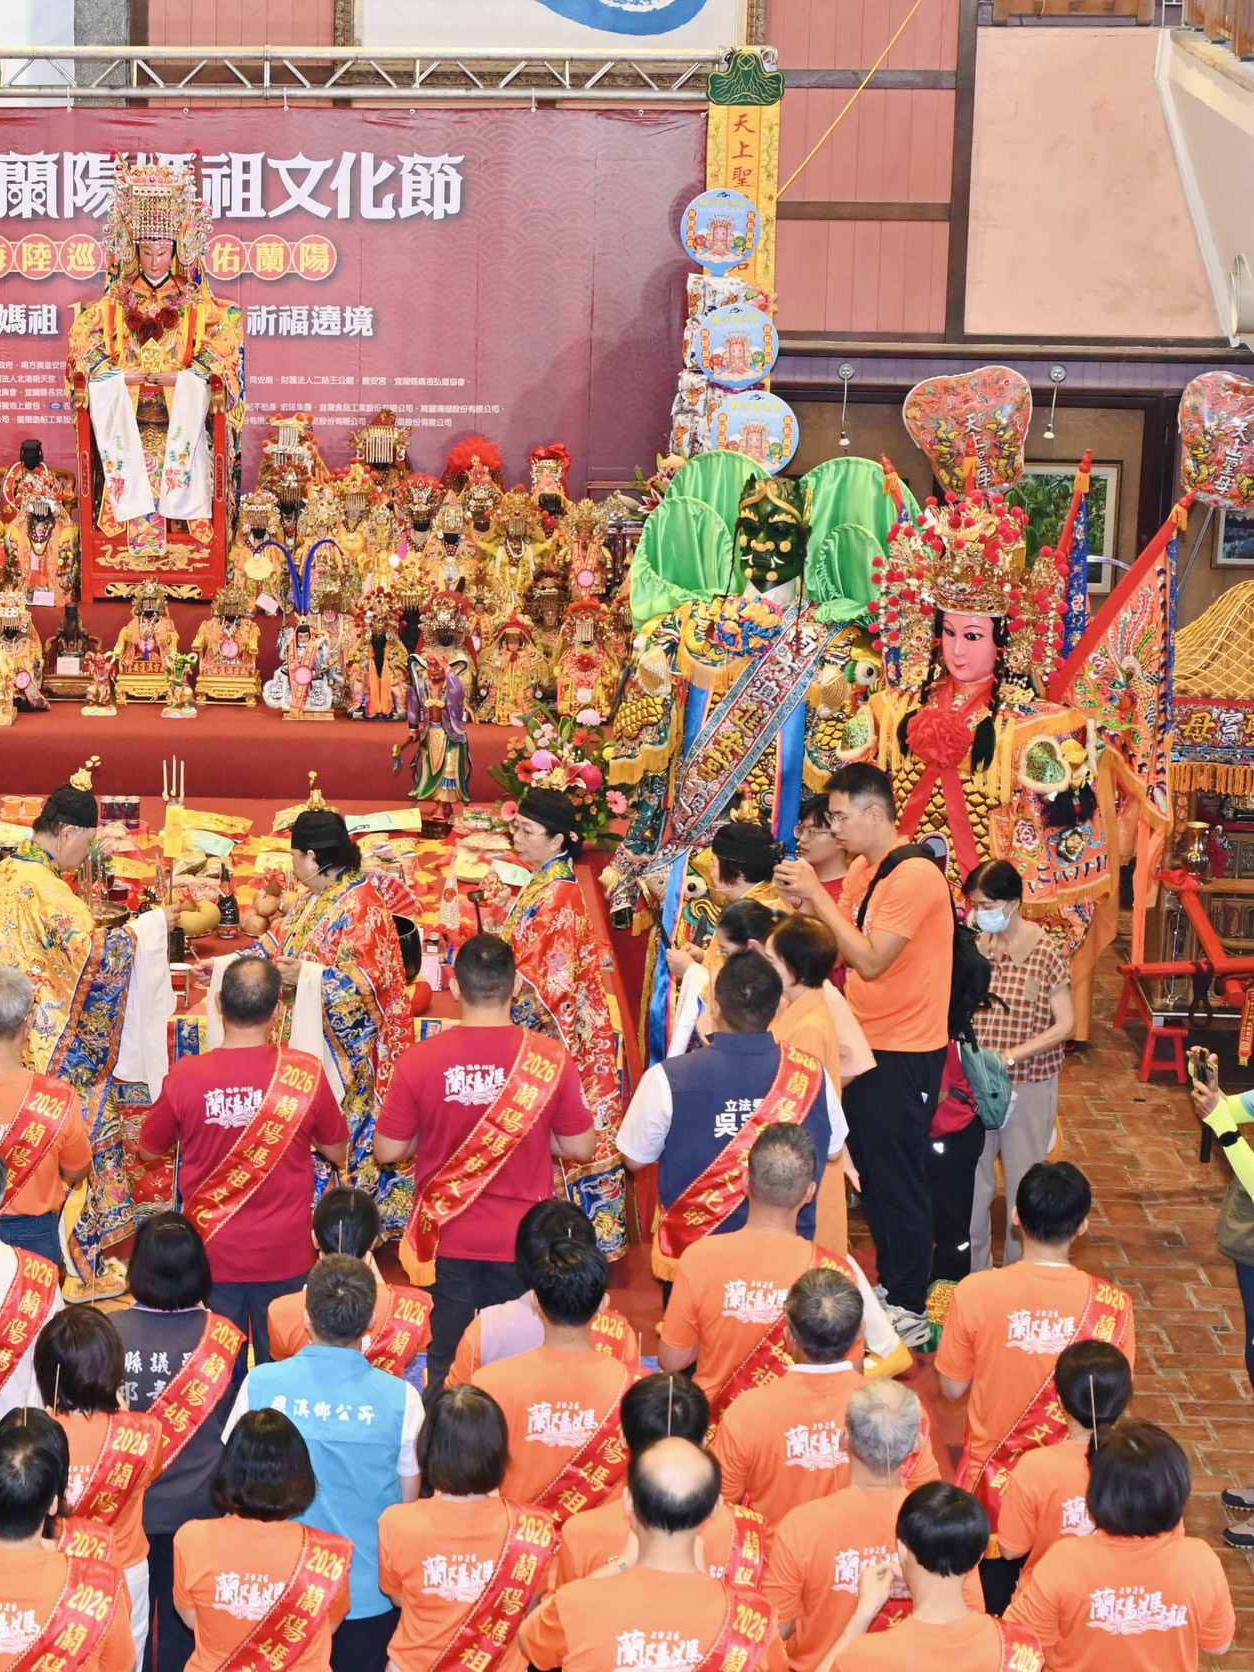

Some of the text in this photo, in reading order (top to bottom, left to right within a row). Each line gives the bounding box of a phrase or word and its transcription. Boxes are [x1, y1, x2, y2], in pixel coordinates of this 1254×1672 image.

[211, 241, 331, 273] 佑蘭陽
[246, 304, 374, 338] 祈福遶境
[1215, 416, 1249, 495] 天上聖母
[787, 1047, 819, 1071] 2026
[280, 1063, 316, 1093] 2026
[4, 1092, 64, 1190] 2026 蘭陽
[418, 1051, 556, 1236] 2026 蘭陽媽祖文化節
[23, 1257, 55, 1288] 2026
[750, 1280, 775, 1288] 2026
[393, 1298, 428, 1327] 2026
[1095, 1283, 1126, 1311] 2026
[592, 1314, 625, 1340] 2026
[1035, 1310, 1059, 1318] 2026
[210, 1321, 241, 1351] 2026
[526, 1401, 599, 1434] 2026 蘭陽媽
[812, 1421, 836, 1430] 2026
[115, 1427, 149, 1458] 2026
[550, 1437, 627, 1524] 陽媽祖
[65, 1532, 104, 1560] 2026
[451, 1554, 476, 1562] 2026
[863, 1545, 888, 1555] 2026
[244, 1573, 270, 1583] 2026
[458, 1515, 552, 1672] 2026 蘭陽媽祖
[67, 1584, 113, 1622] 2026
[240, 1548, 345, 1672] 2026 蘭陽媽
[1089, 1586, 1188, 1630] 2026 蘭陽媽祖
[731, 1604, 767, 1643] 2026
[616, 1630, 703, 1666] 2026 蘭陽媽
[1010, 1643, 1043, 1672] 2026
